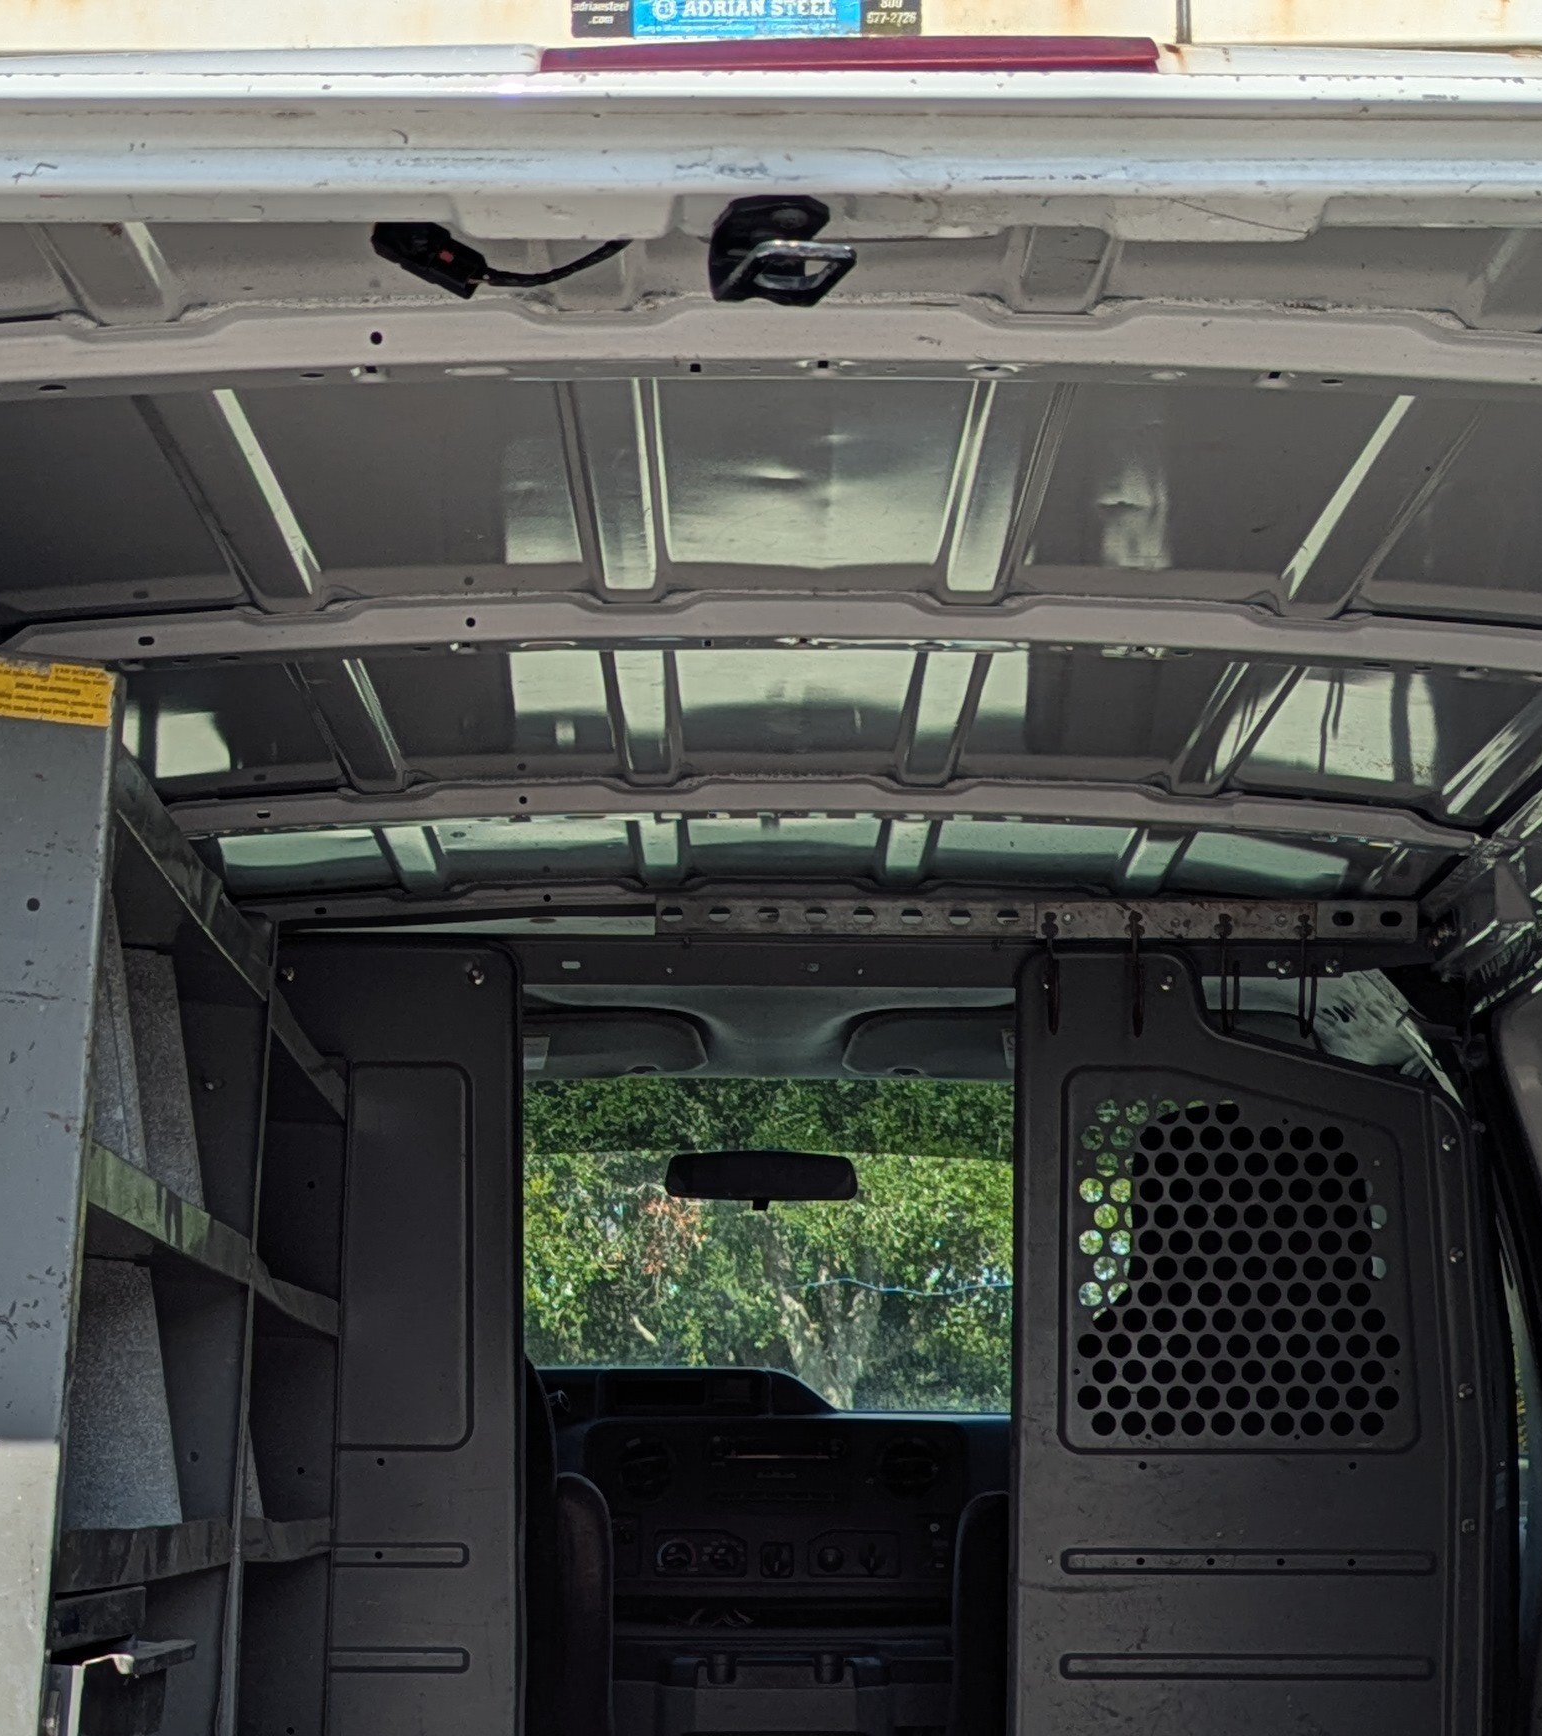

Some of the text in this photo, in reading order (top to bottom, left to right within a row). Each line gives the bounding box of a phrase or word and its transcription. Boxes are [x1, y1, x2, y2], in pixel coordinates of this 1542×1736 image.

[682, 0, 837, 17] ADRIAN STEEL
[588, 15, 614, 25] .com
